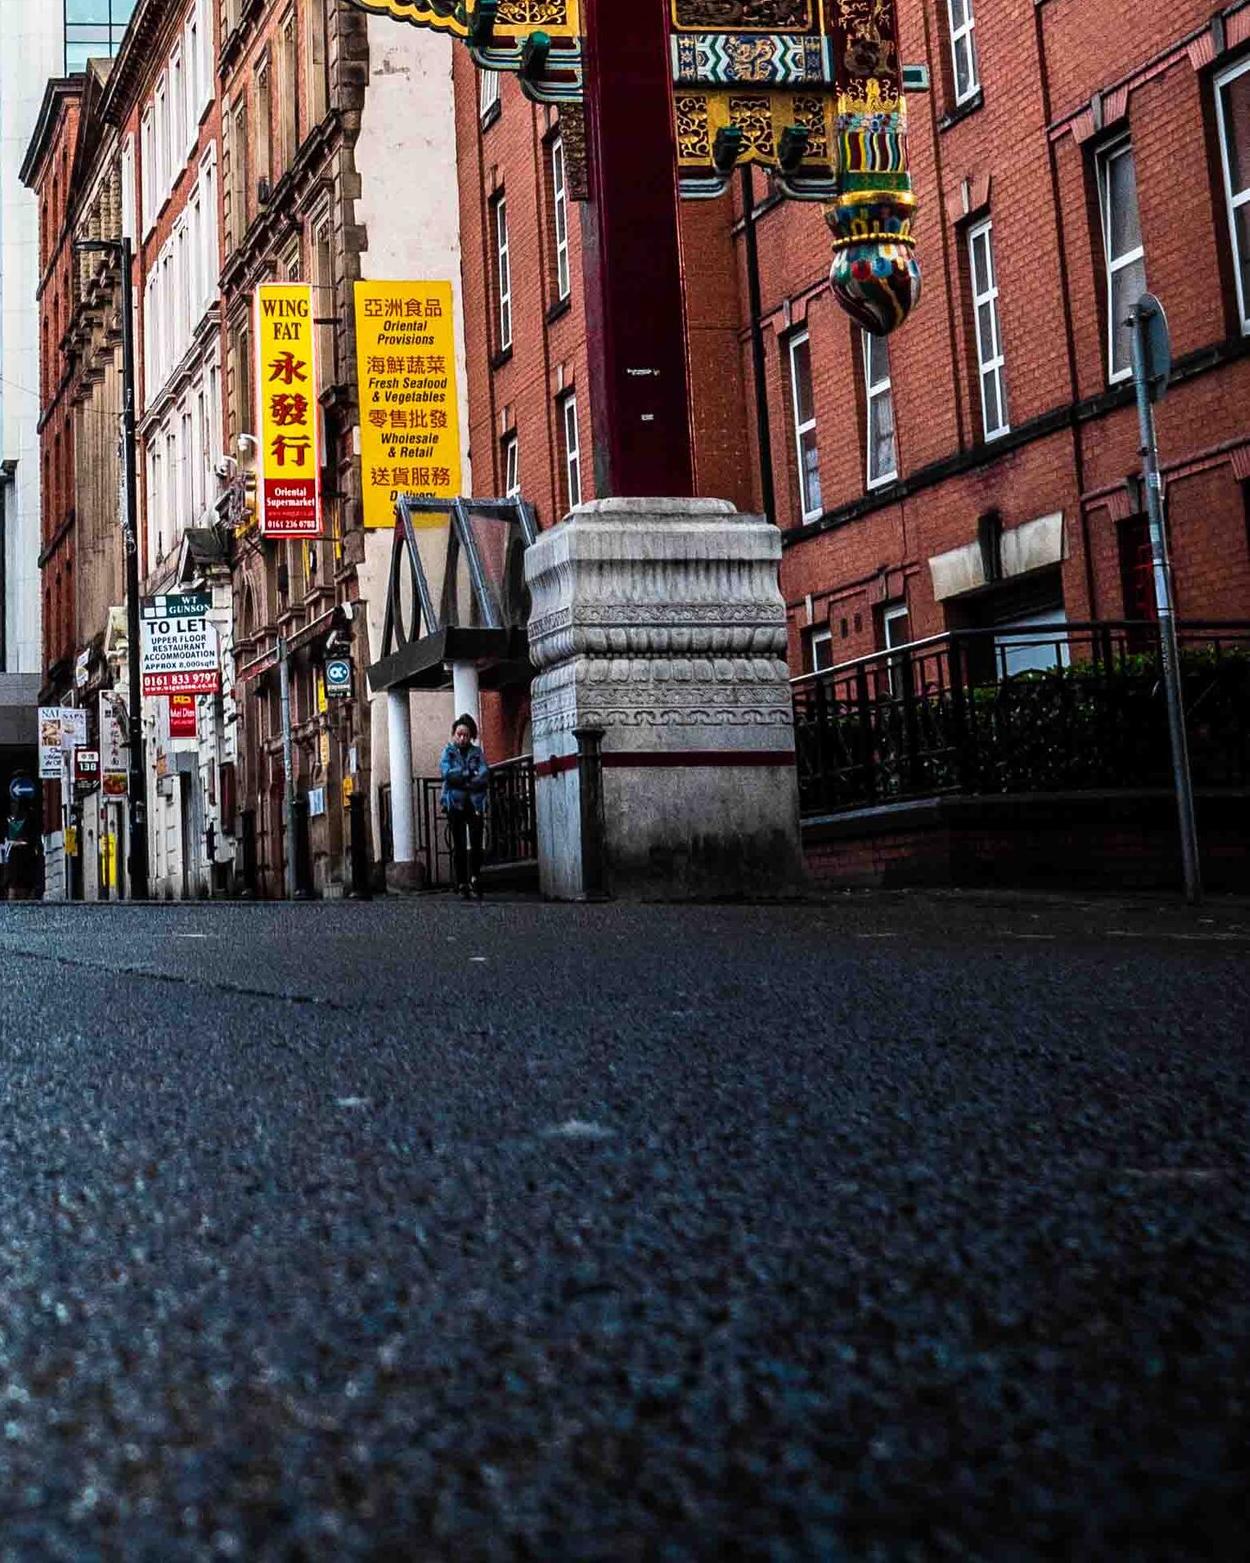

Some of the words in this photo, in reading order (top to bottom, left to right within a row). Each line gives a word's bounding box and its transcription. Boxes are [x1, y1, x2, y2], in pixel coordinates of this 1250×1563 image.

[261, 299, 309, 317] WING
[363, 298, 442, 317] 亞洲食品
[273, 322, 301, 340] FAT
[383, 320, 428, 331] Oriental
[377, 333, 435, 345] Provisions
[366, 356, 446, 375] 海鮮蔬菜
[368, 377, 400, 389] Fresh
[403, 377, 447, 389] Seafood
[372, 392, 380, 402] &
[385, 391, 446, 404] Vegetables
[267, 351, 312, 466] 永發行
[368, 409, 448, 429] 零售批發
[381, 433, 439, 444] Wholesale
[388, 447, 396, 458] &
[400, 446, 433, 458] Retail
[371, 467, 451, 487] 送貨服務
[274, 487, 307, 496] Oriental
[266, 497, 315, 509] Supermarket
[267, 520, 284, 529] 0161
[285, 520, 298, 529] 236
[182, 596, 197, 604] WT
[147, 621, 170, 634] TO
[177, 619, 207, 632] LET
[152, 636, 177, 644] UPPER
[180, 634, 206, 643] FLOOR
[152, 643, 206, 652] RESTAURANT
[144, 650, 215, 661] ACCOMMODATION
[145, 661, 177, 670] APPROX
[144, 676, 168, 686] 0161
[171, 674, 190, 684] 833
[193, 672, 217, 683] 9797
